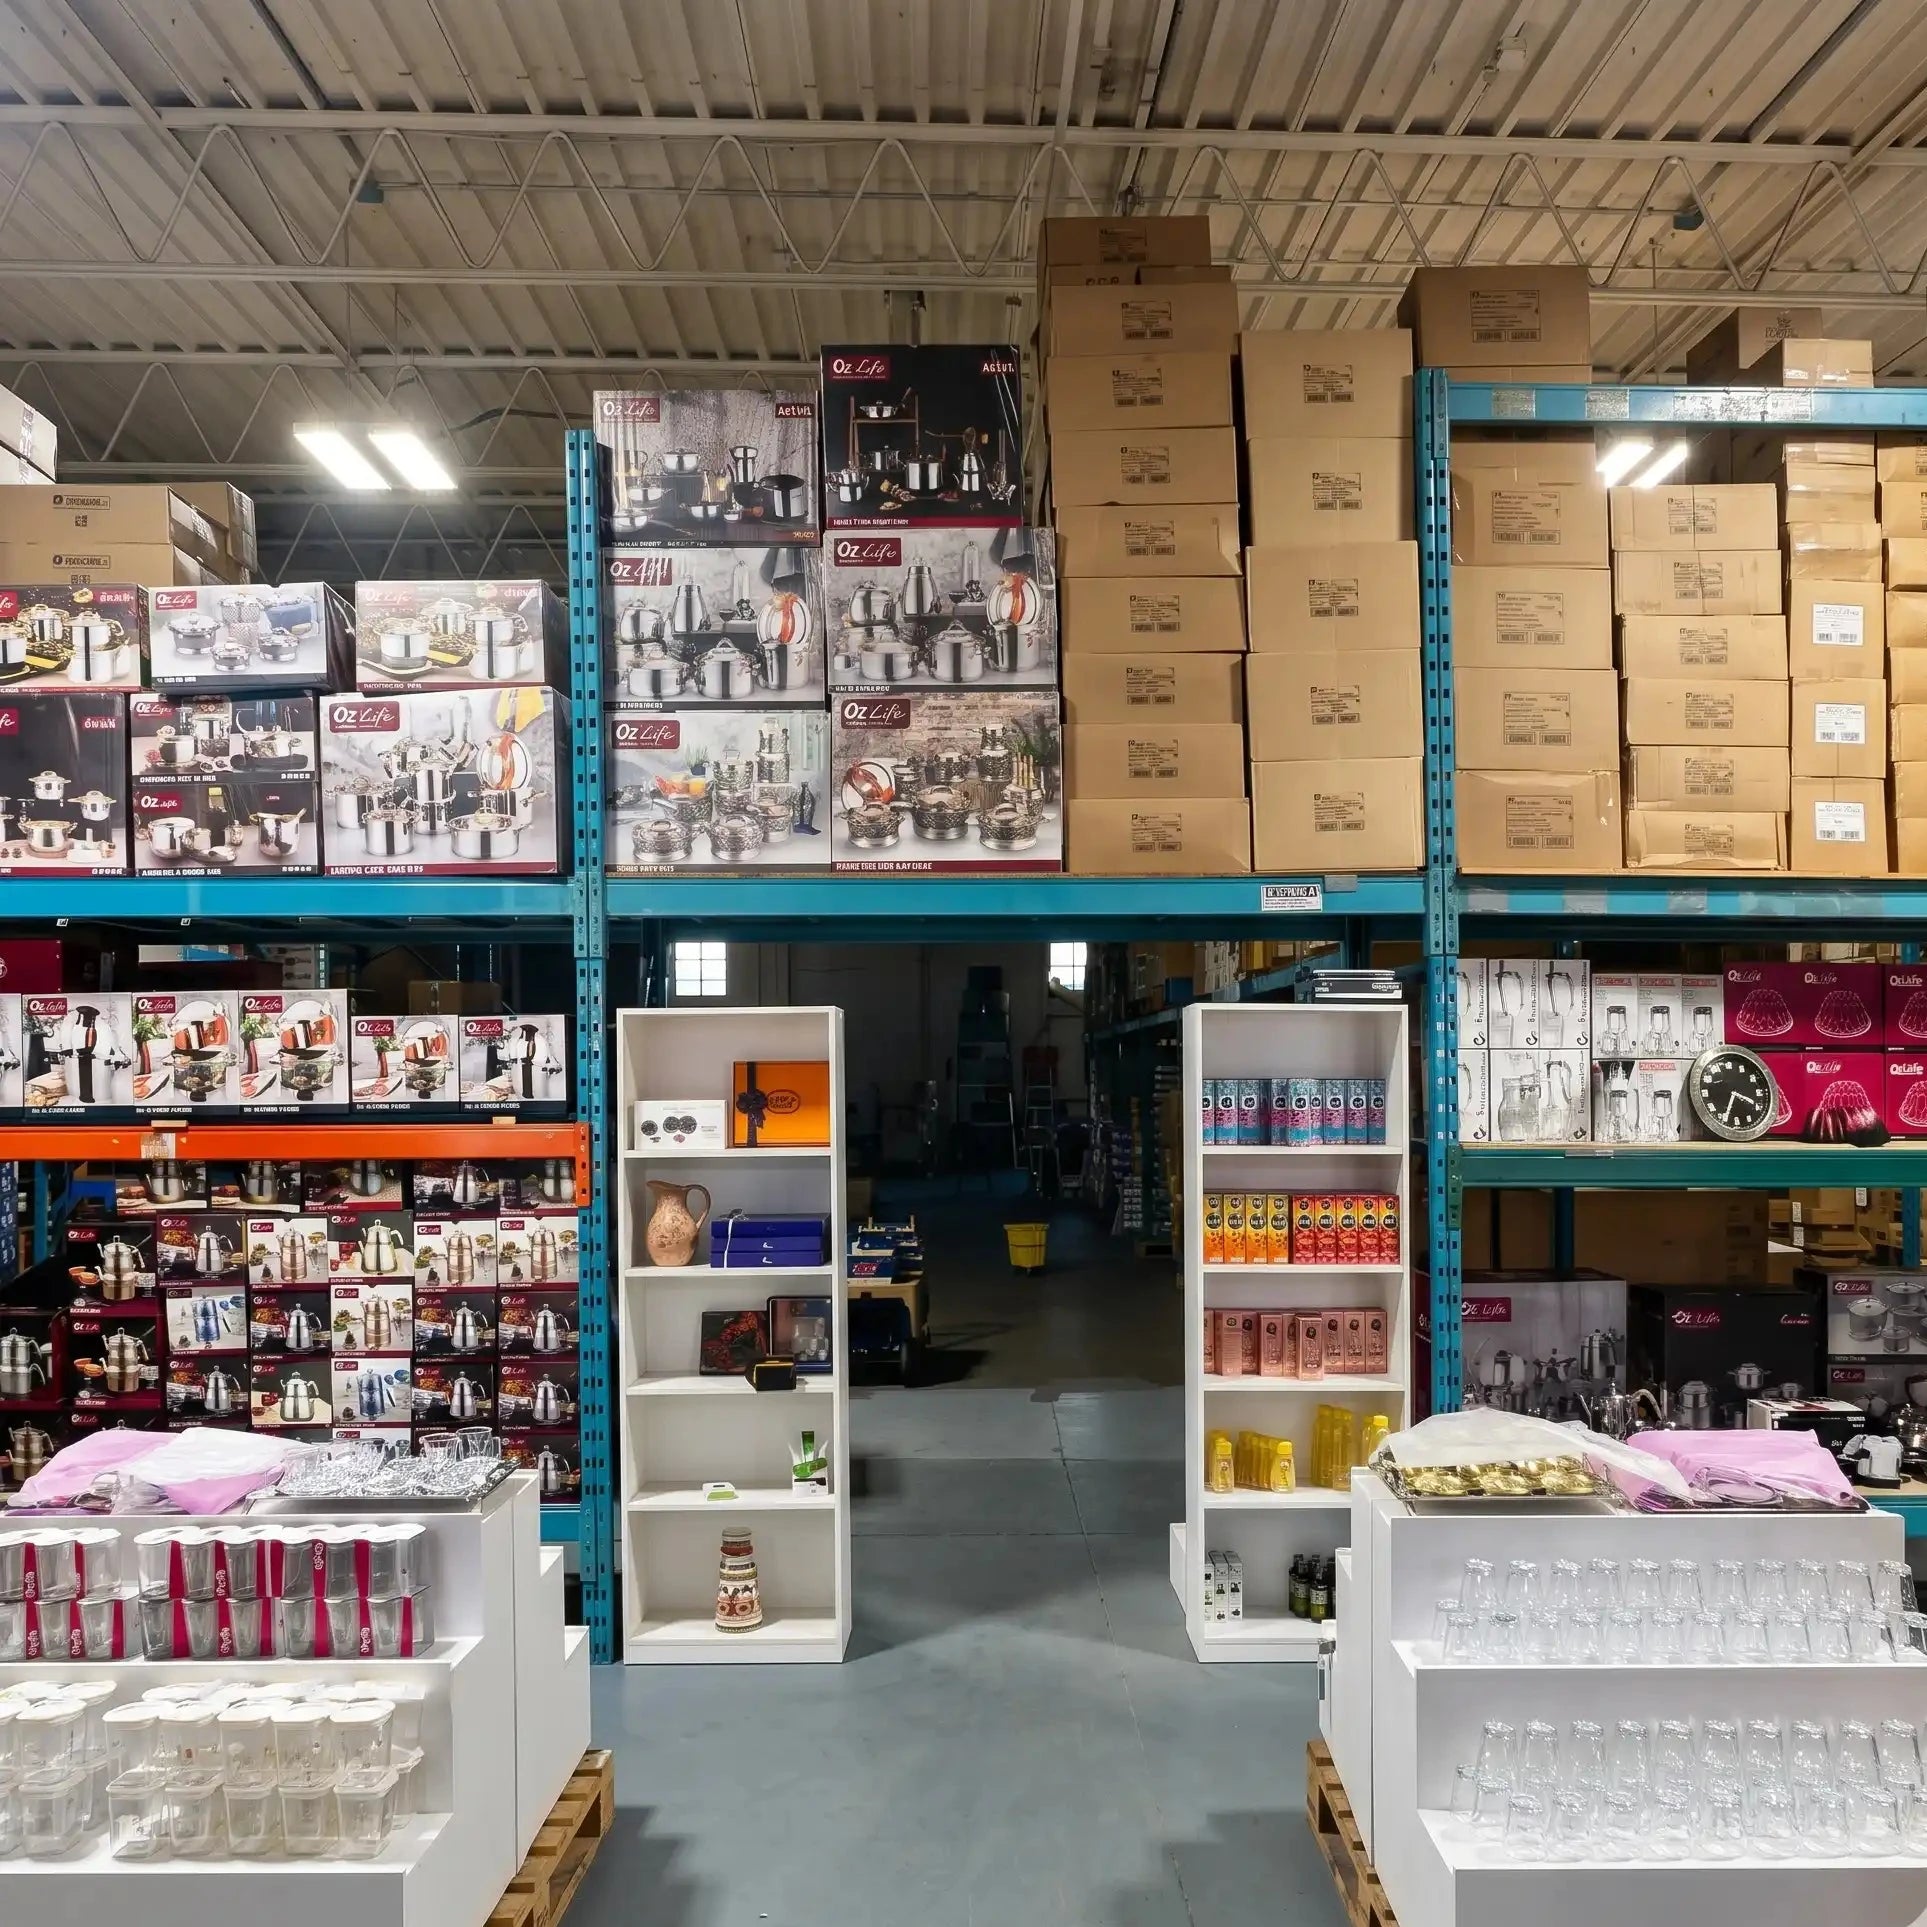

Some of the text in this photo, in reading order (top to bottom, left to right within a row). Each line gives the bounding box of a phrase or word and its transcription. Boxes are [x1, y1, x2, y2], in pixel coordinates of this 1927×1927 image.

[833, 359, 853, 374] Oz
[603, 401, 622, 416] Oz
[837, 541, 896, 562] Oz Life
[610, 561, 632, 577] Oz
[333, 706, 394, 727] Oz Life
[844, 702, 907, 724] Oz Life
[616, 723, 675, 745] Oz Life
[140, 796, 158, 808] Oz
